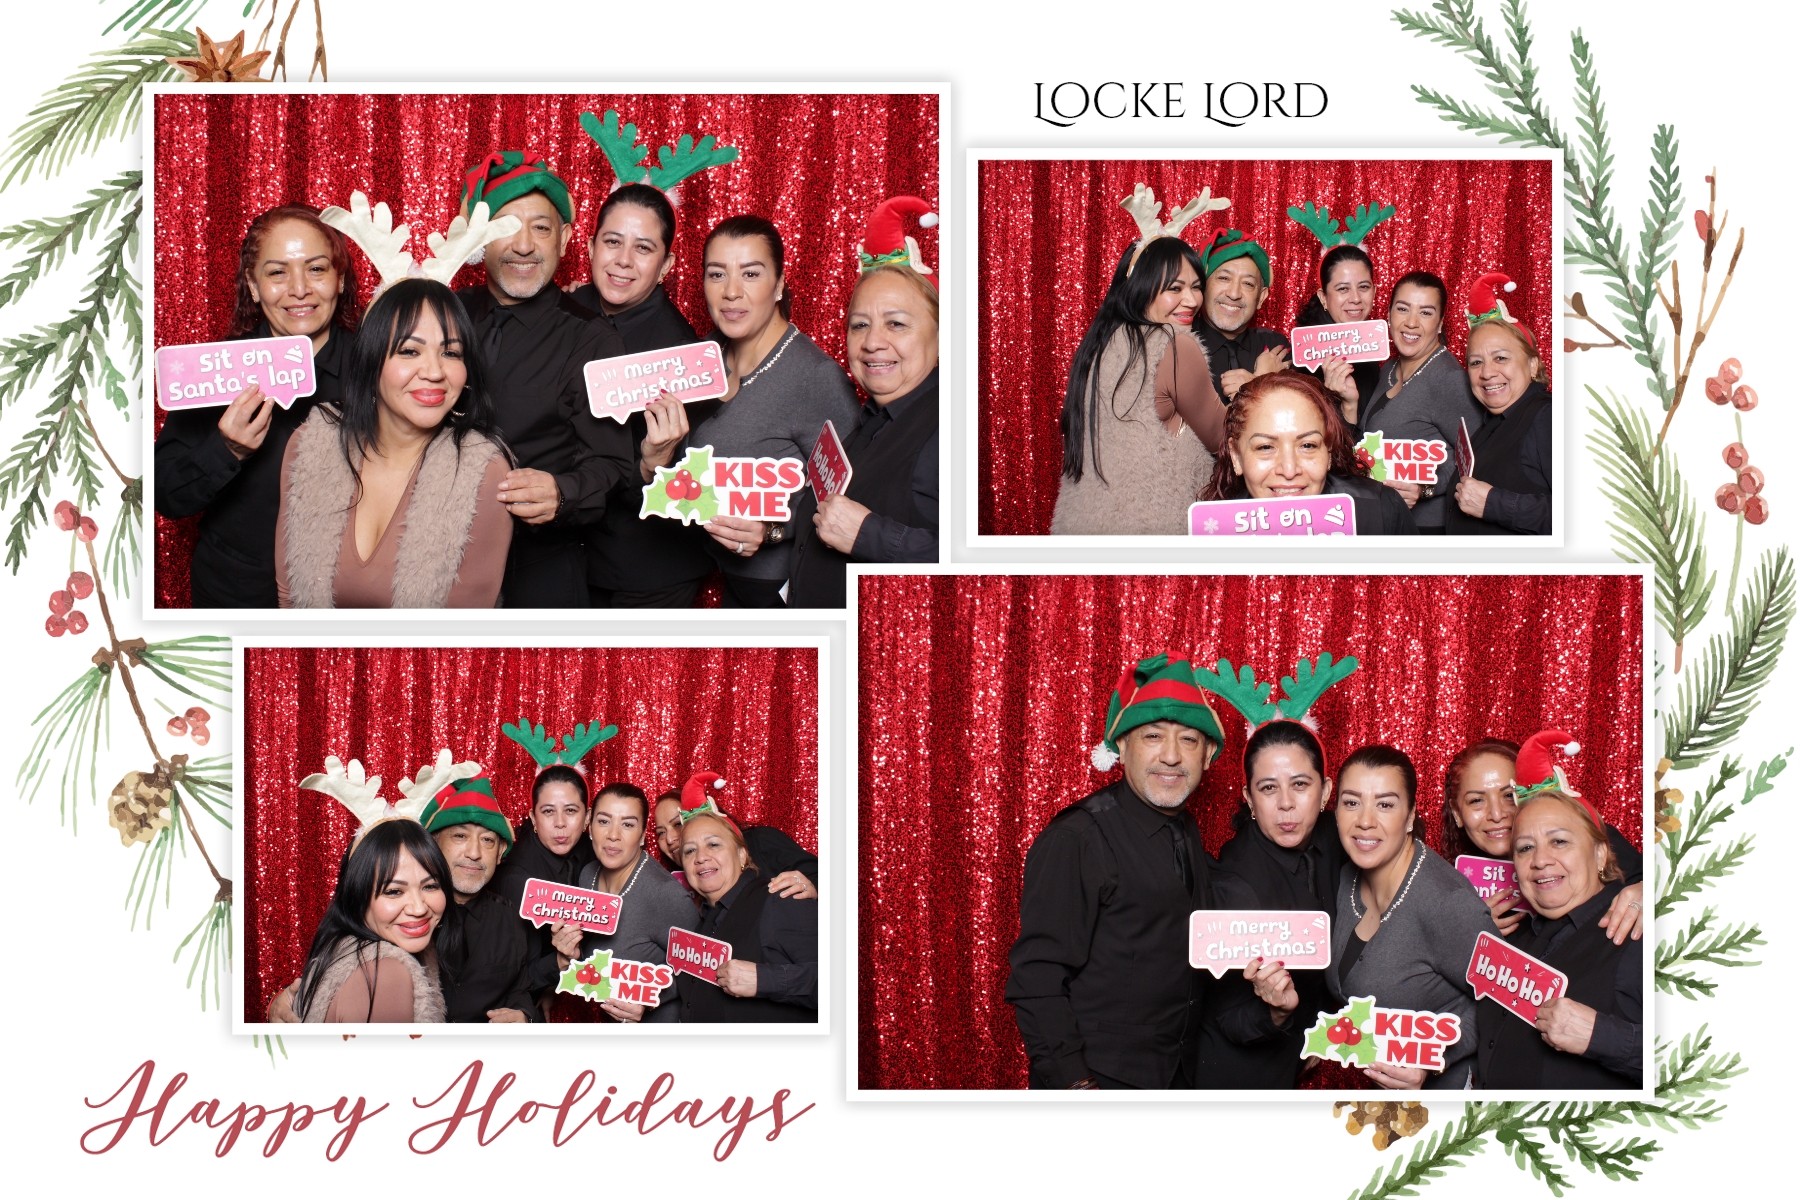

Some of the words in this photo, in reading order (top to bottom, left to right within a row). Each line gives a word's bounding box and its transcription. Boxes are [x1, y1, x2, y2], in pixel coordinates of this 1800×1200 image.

[1318, 329, 1361, 342] Merry
[200, 349, 233, 373] Sit
[242, 349, 273, 366] on
[1303, 341, 1379, 361] Christmas
[624, 356, 687, 380] Merry
[168, 371, 260, 402] Santa's
[268, 365, 306, 390] lap
[605, 371, 713, 408] Christmas
[1384, 442, 1445, 462] KISS
[715, 462, 801, 489] KISS
[1394, 463, 1435, 482] ME
[729, 491, 787, 518] ME
[1234, 507, 1270, 533] Sit
[1279, 508, 1313, 528] on
[1482, 865, 1506, 882] Sit
[551, 890, 595, 911] Merry
[532, 902, 609, 924] Christmas
[1229, 920, 1292, 940] Merry
[1205, 938, 1316, 960] Christmas
[611, 962, 670, 986] KISS
[618, 982, 659, 1004] ME
[1375, 1012, 1457, 1042] KISS
[1387, 1040, 1442, 1067] ME
